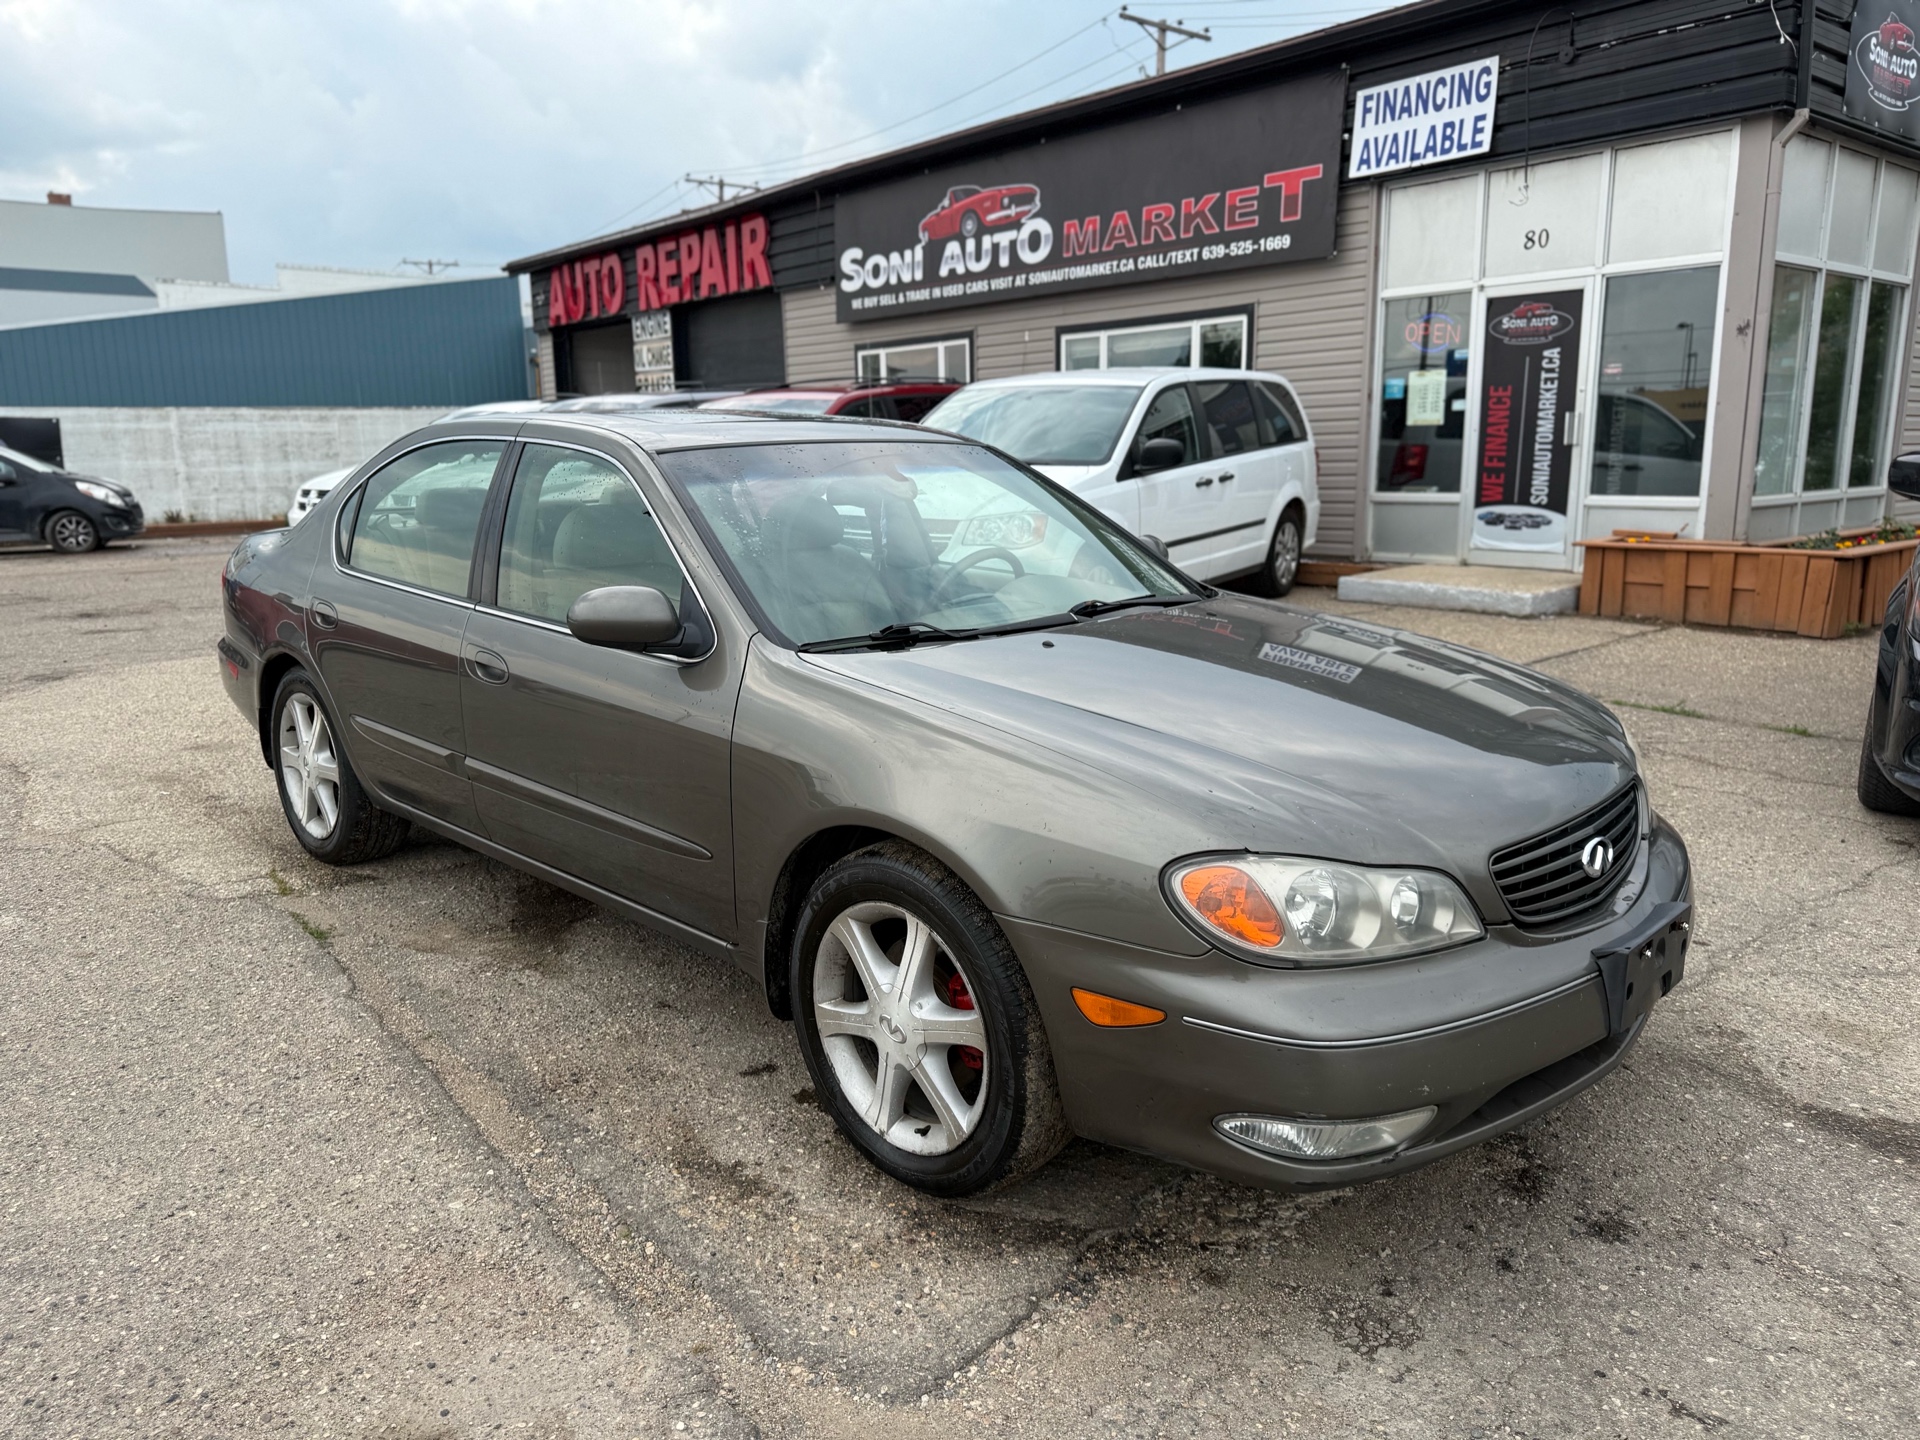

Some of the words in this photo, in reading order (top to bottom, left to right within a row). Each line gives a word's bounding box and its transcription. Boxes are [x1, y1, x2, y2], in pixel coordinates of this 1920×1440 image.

[1869, 36, 1889, 68] SONI
[1889, 55, 1918, 79] AUTO
[1361, 65, 1492, 128] FINANCING
[1356, 113, 1487, 172] AVAILABLE
[839, 244, 924, 292] SONI
[939, 218, 1054, 277] AUTO
[1063, 163, 1323, 257] MARKET
[1523, 228, 1550, 250] 80
[549, 252, 626, 327] AUTO
[635, 212, 773, 311] REPAIR
[851, 297, 863, 310] WE
[864, 295, 878, 309] BUY
[879, 293, 897, 307] SELL
[898, 291, 905, 304] &
[905, 287, 931, 303] TRADE
[931, 286, 941, 299] IN
[942, 283, 965, 297] USED
[965, 279, 989, 294] CARS
[989, 275, 1013, 291] VISIT
[1014, 273, 1027, 287] AT
[1028, 256, 1135, 286] SONIAUTOMARKET.CA
[1137, 247, 1200, 270] CALL/TEXT
[1202, 234, 1291, 261] 639-525-1669
[634, 311, 669, 339] ENGINE
[1405, 323, 1461, 344] OPEN
[1501, 316, 1527, 329] SONI
[1530, 315, 1558, 327] AUTO
[646, 344, 671, 367] CHANGE
[1483, 384, 1512, 468] FINANCE
[1530, 347, 1561, 506] SONIAUTOMARKET.CA
[1481, 472, 1505, 503] WE
